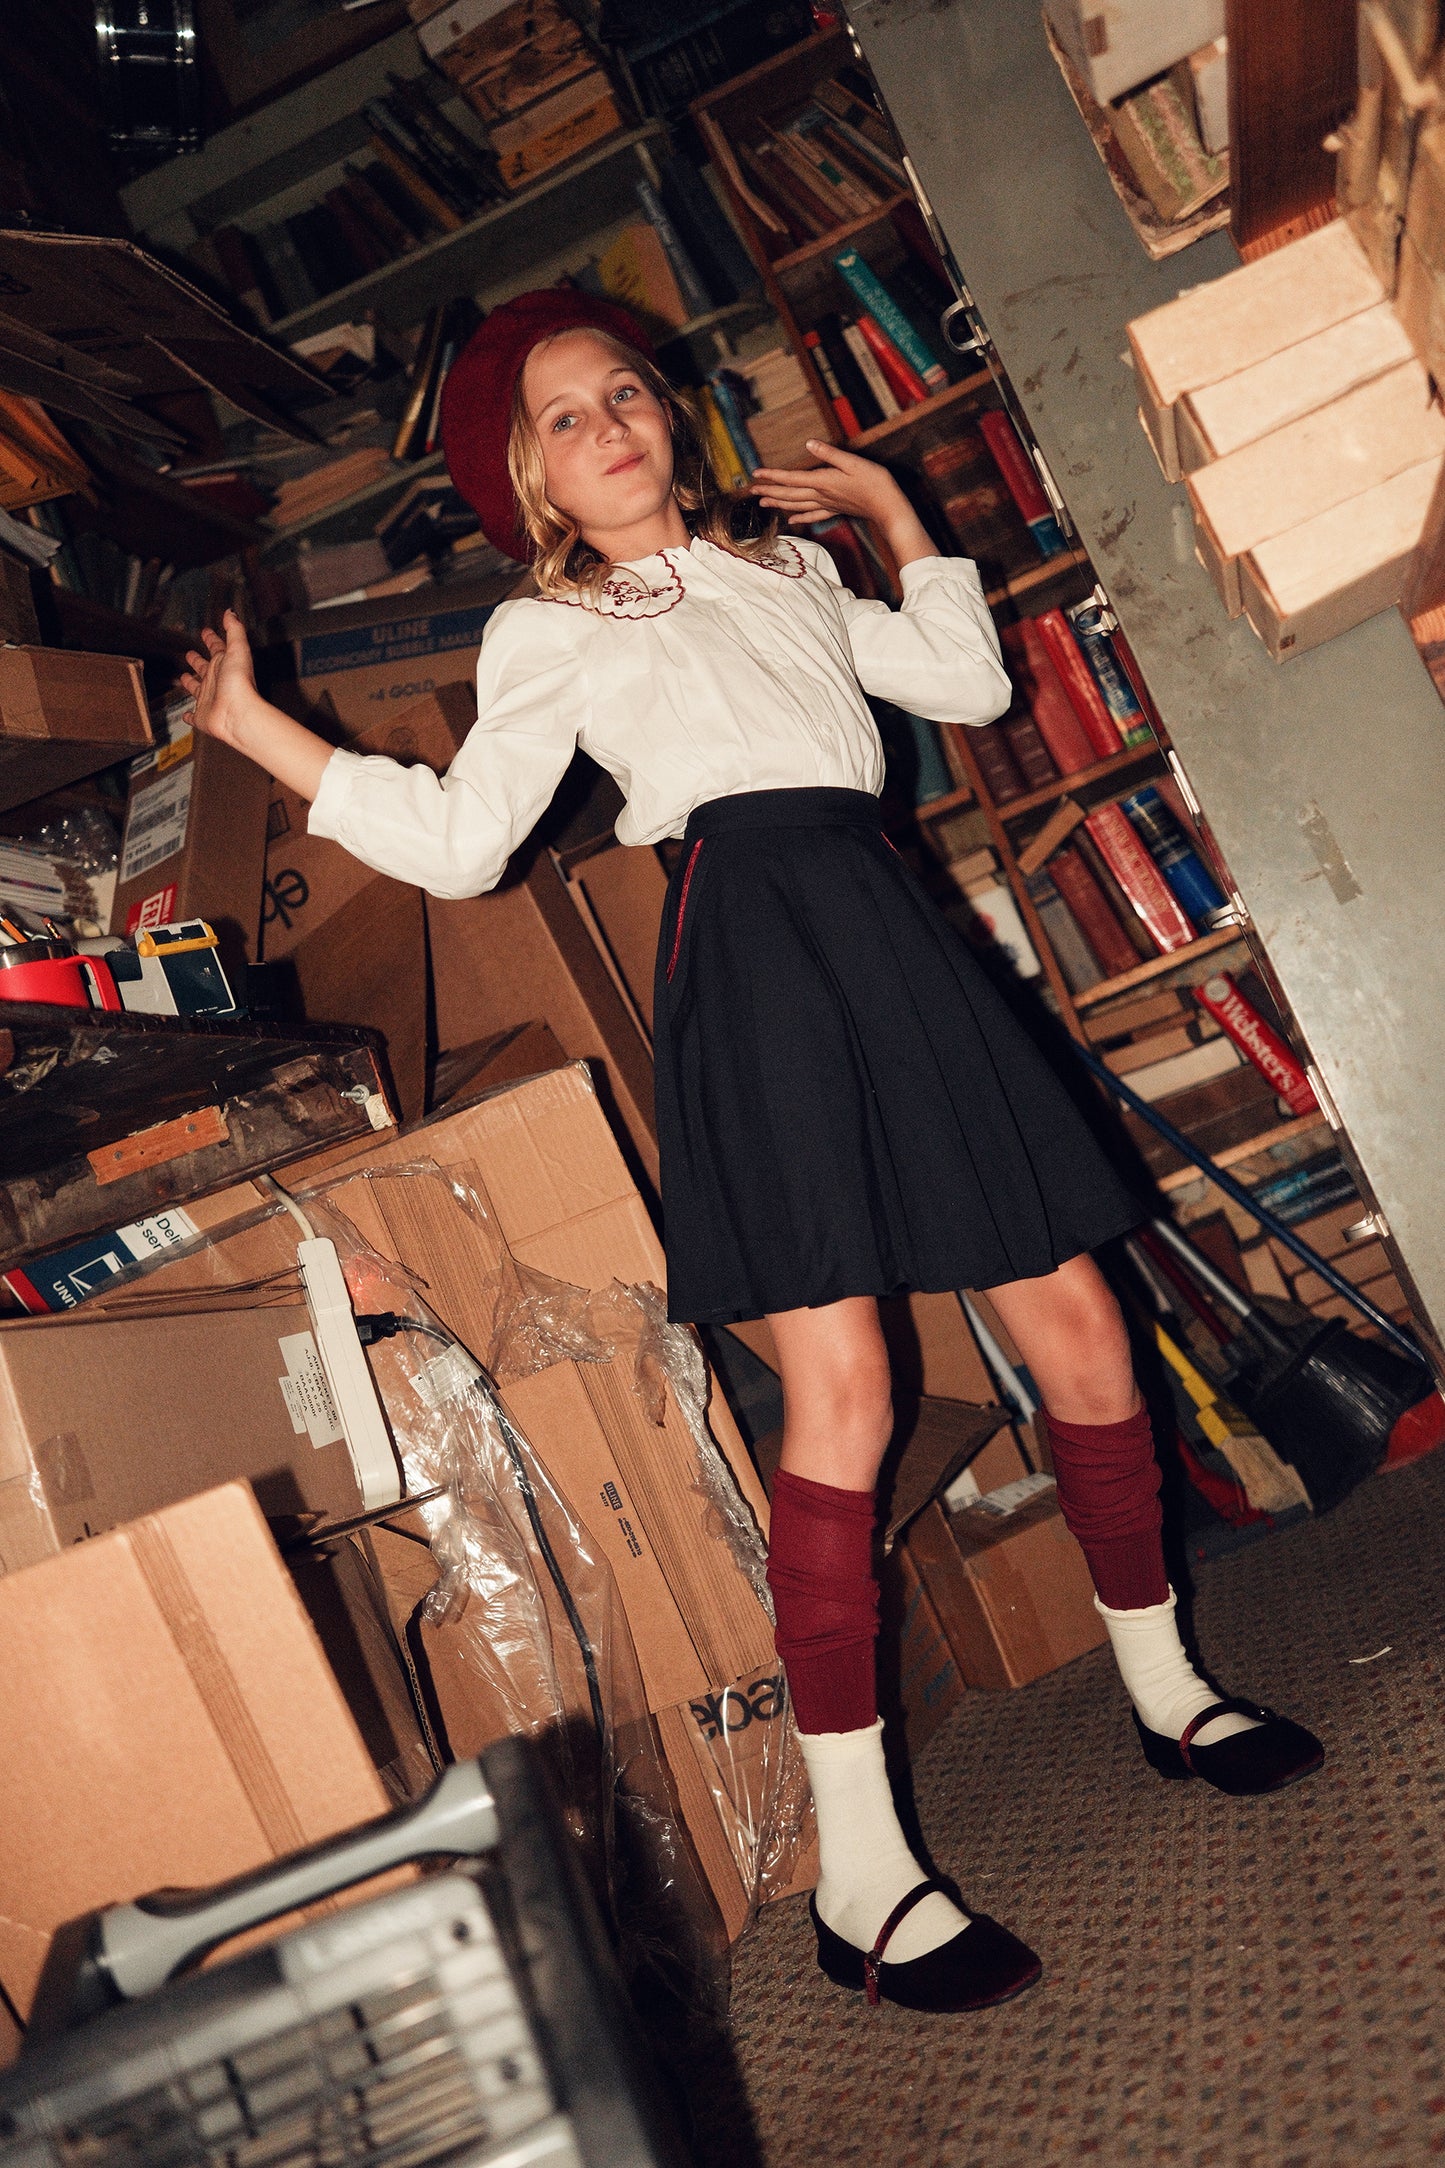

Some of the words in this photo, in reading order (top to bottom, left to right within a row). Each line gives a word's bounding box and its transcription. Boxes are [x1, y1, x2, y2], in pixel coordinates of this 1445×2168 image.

[372, 618, 430, 645] ULINE
[1221, 994, 1295, 1092] Webster's
[605, 1482, 621, 1510] ULINE
